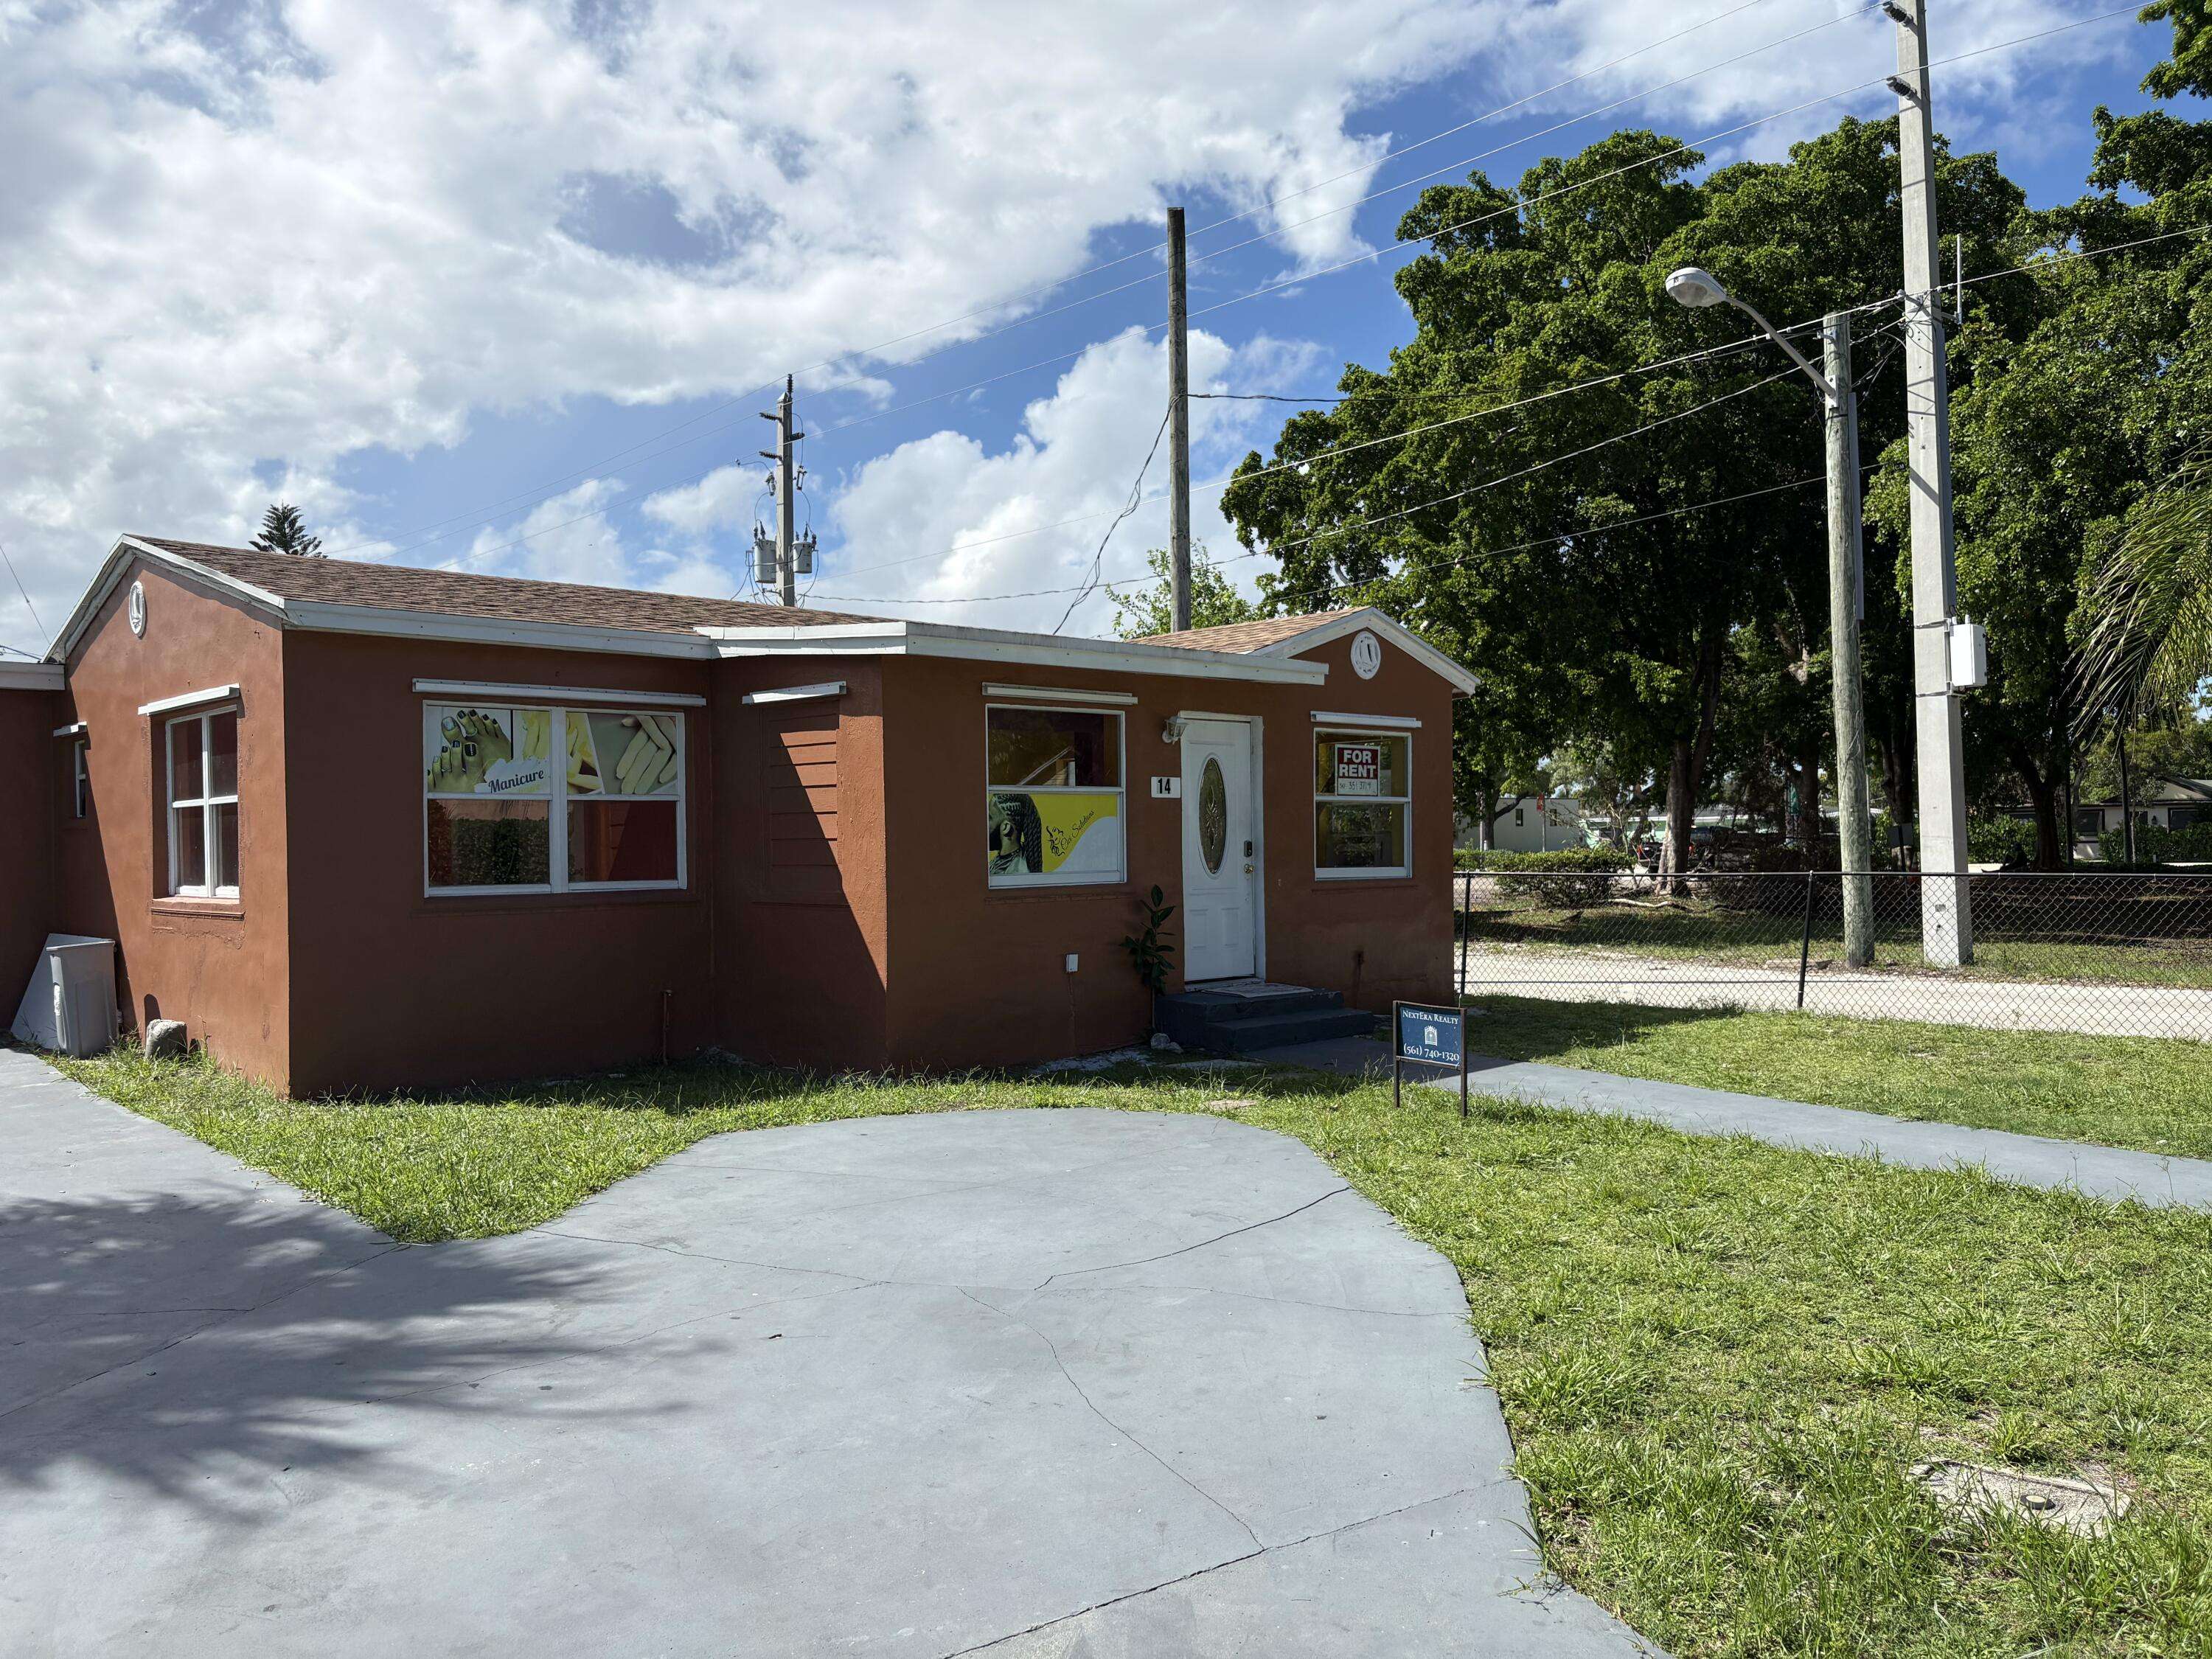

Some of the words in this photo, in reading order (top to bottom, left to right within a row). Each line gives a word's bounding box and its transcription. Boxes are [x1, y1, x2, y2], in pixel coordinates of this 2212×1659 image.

[1343, 749, 1372, 763] FOR
[1339, 764, 1377, 779] RENT
[488, 769, 544, 793] Manicure
[1158, 777, 1171, 794] 14
[1403, 1043, 1422, 1056] (561)
[1424, 1049, 1459, 1061] 740-1320
